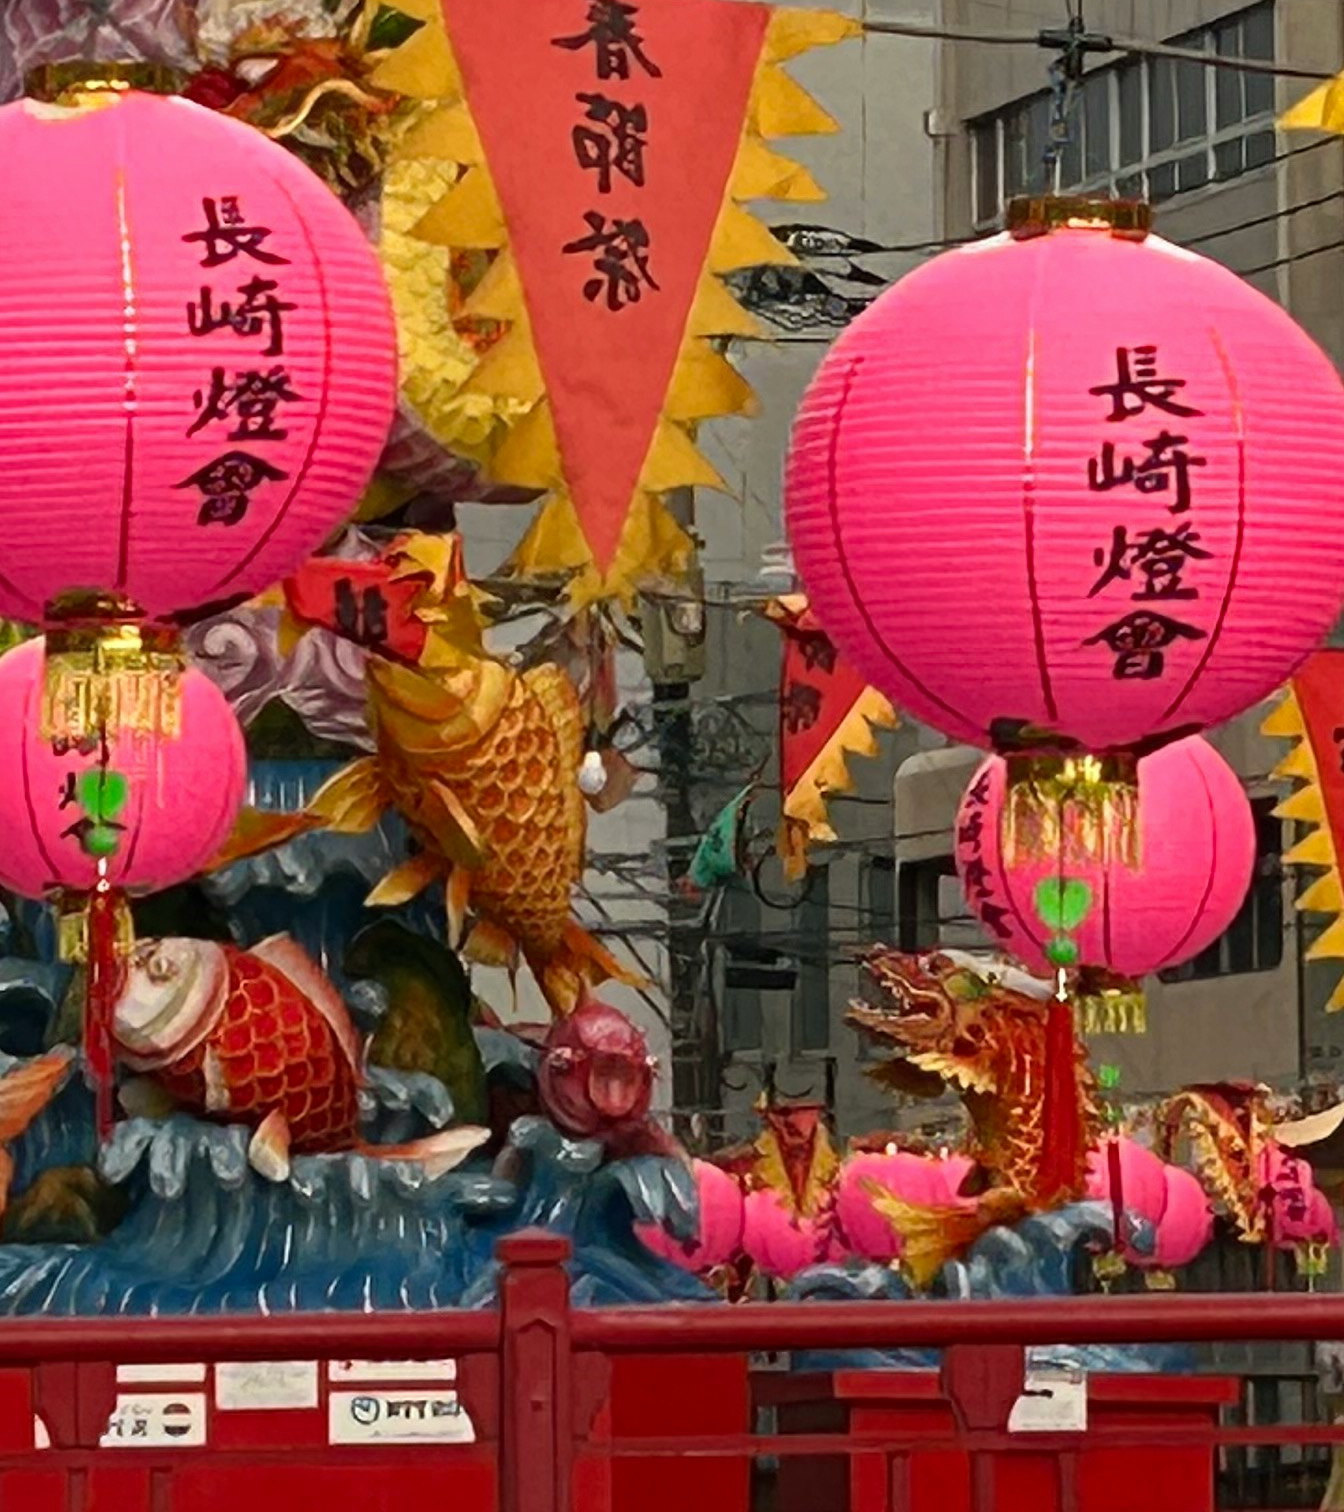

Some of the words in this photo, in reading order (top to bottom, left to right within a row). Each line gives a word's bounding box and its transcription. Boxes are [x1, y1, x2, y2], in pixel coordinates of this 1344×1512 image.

[170, 196, 304, 526] 長崎燈會
[1081, 345, 1214, 680] 長崎燈會
